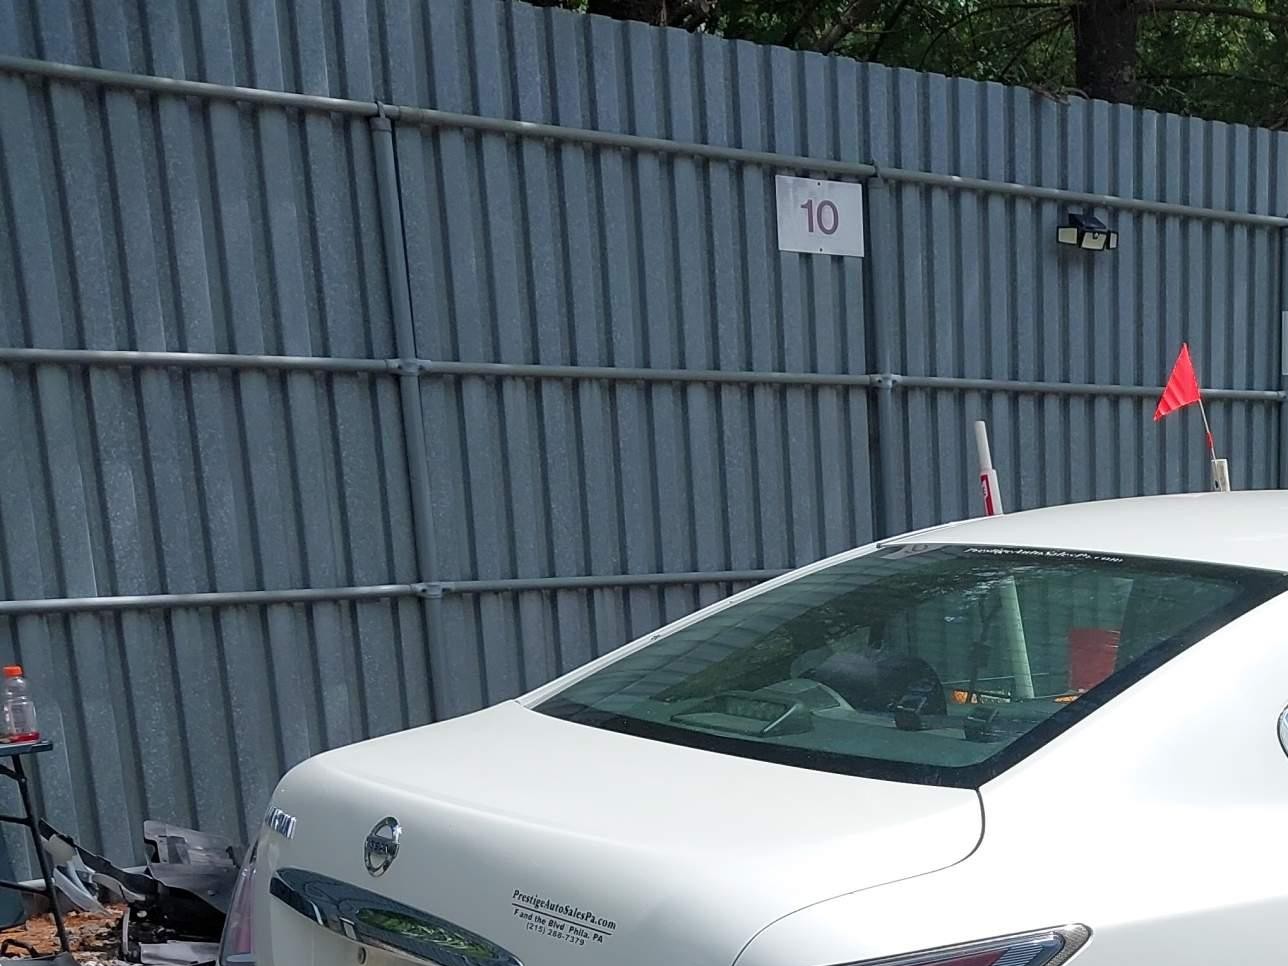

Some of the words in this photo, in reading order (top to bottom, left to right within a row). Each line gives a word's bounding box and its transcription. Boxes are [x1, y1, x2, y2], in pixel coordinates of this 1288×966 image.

[801, 199, 839, 235] 10
[512, 890, 616, 929] PrestigeAutoSalesPa.com
[520, 911, 532, 920] and
[534, 915, 547, 925] the
[548, 919, 565, 931] Blvd
[592, 933, 603, 943] PA
[526, 922, 546, 935] (215)
